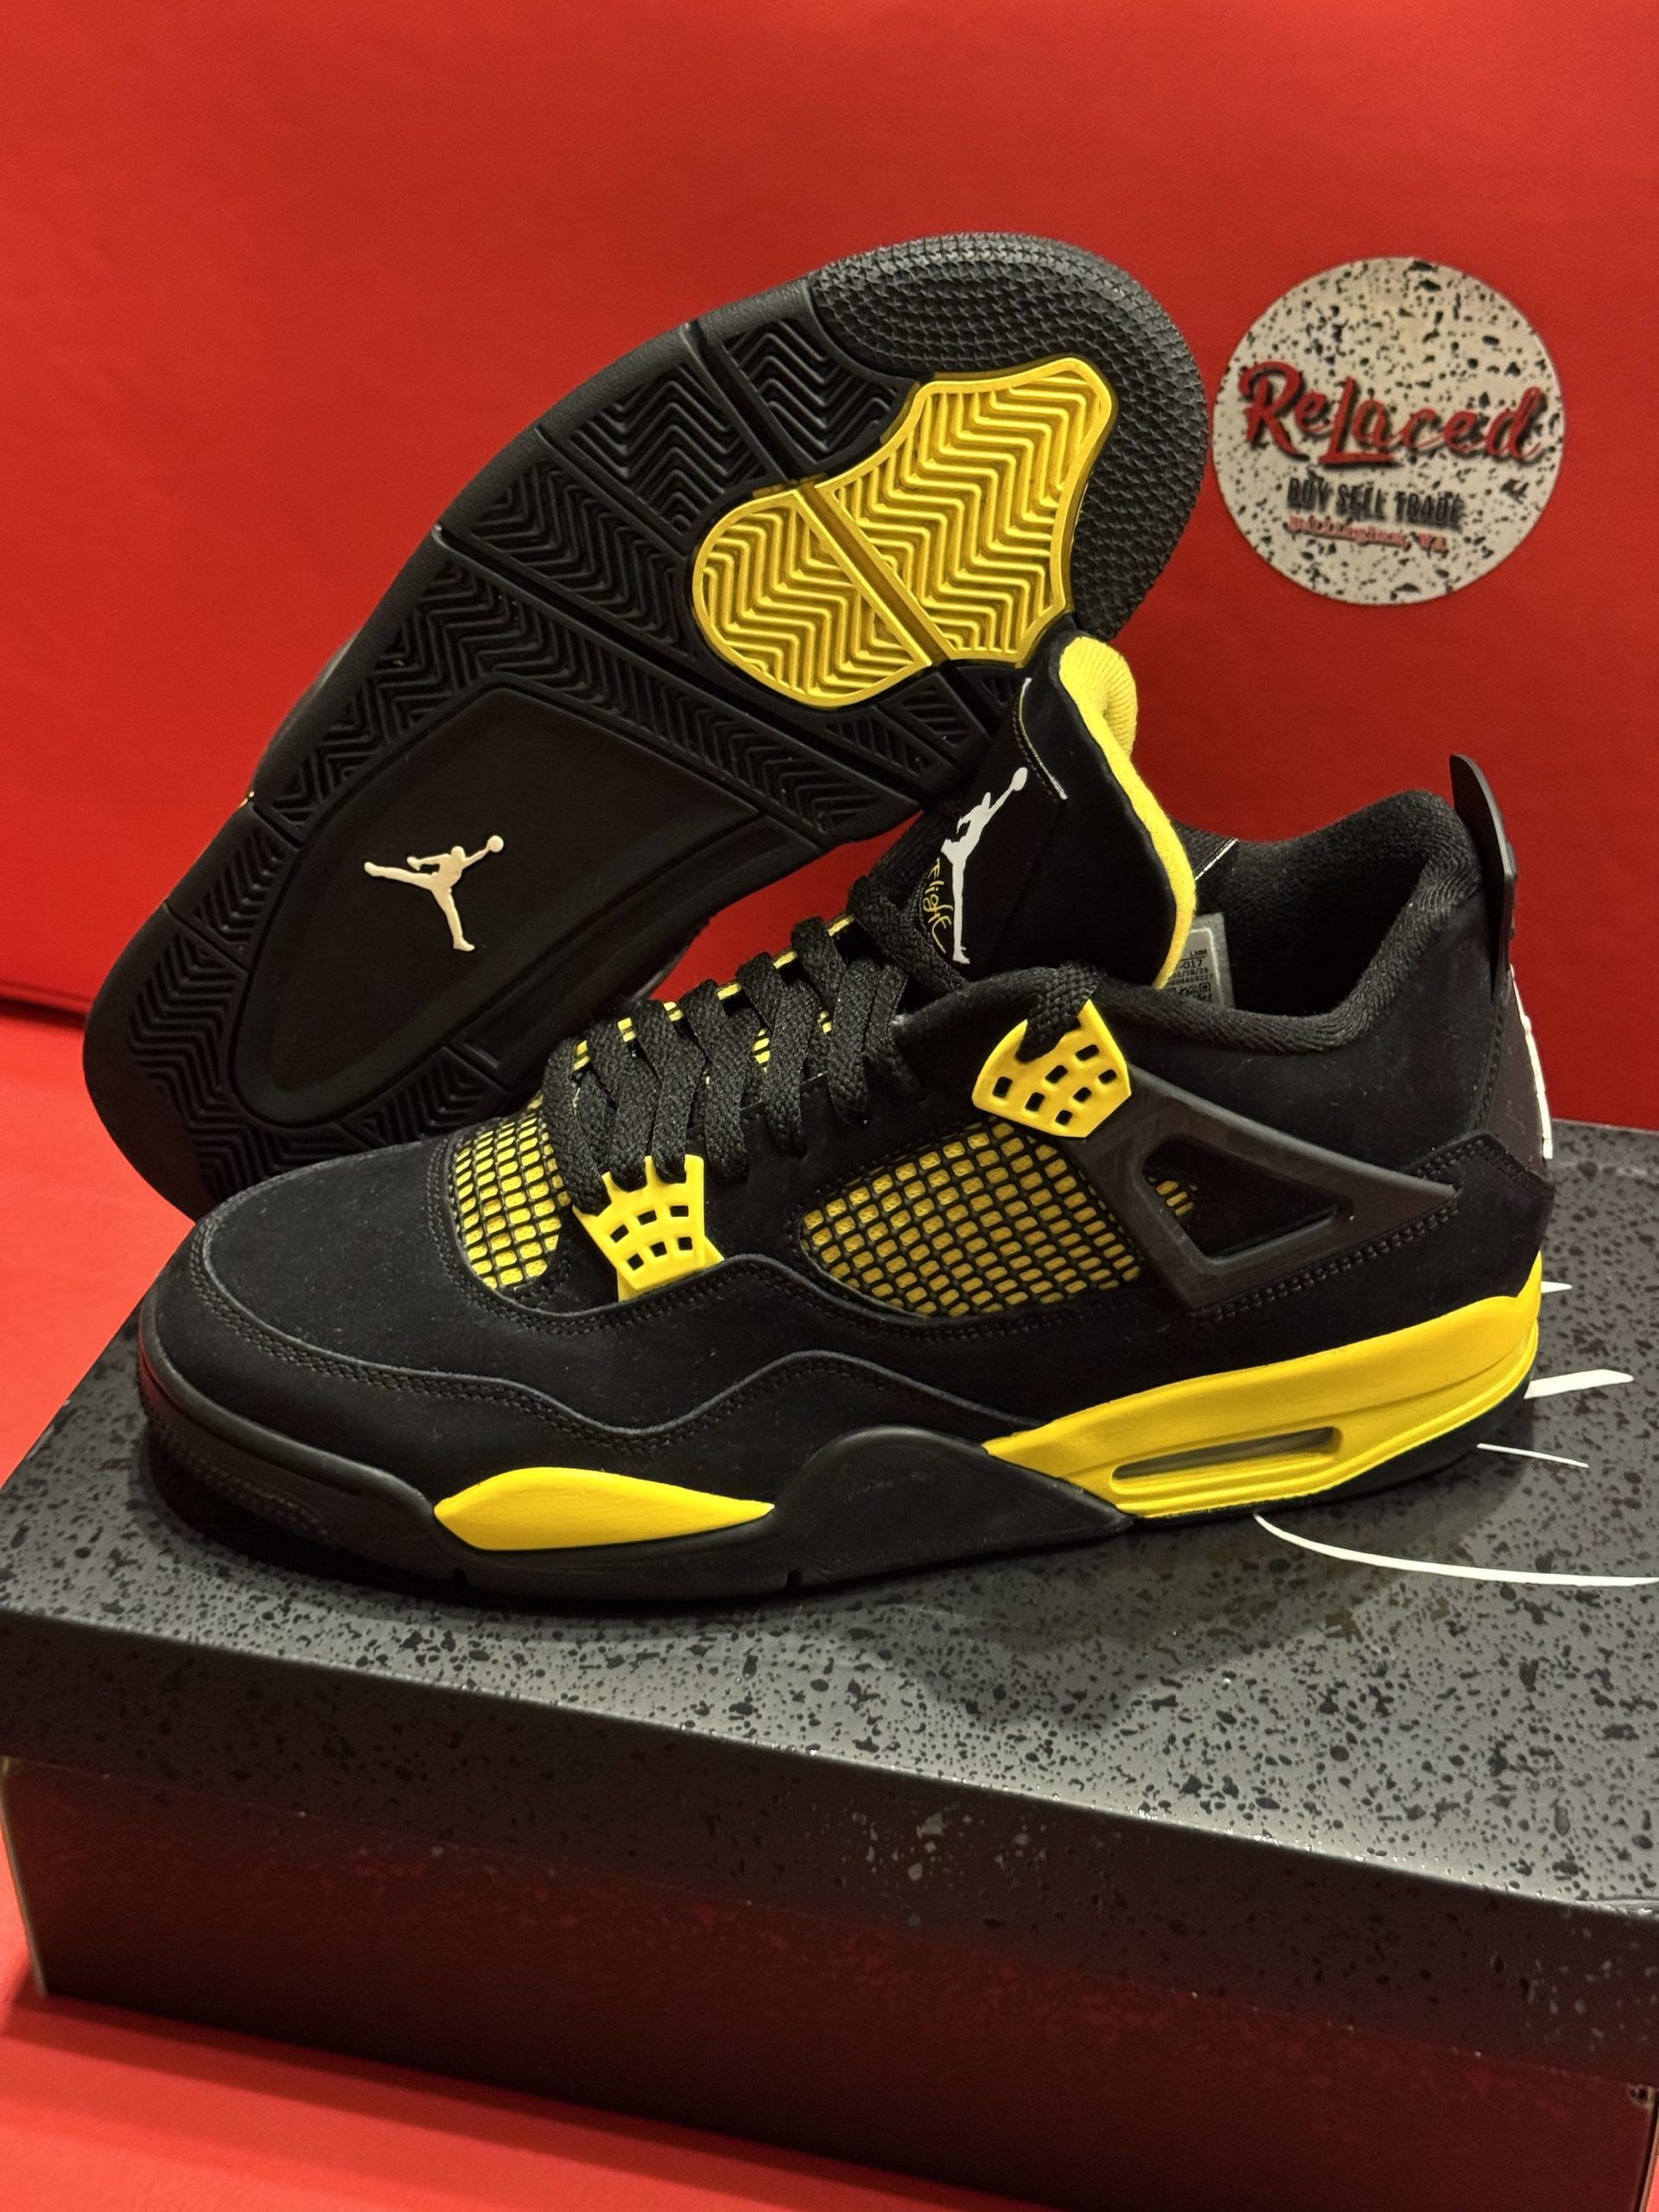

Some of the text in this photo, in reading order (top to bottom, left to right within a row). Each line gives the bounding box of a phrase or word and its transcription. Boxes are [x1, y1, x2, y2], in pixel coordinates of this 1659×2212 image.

[1287, 477, 1465, 532] BUY SELL TRADE
